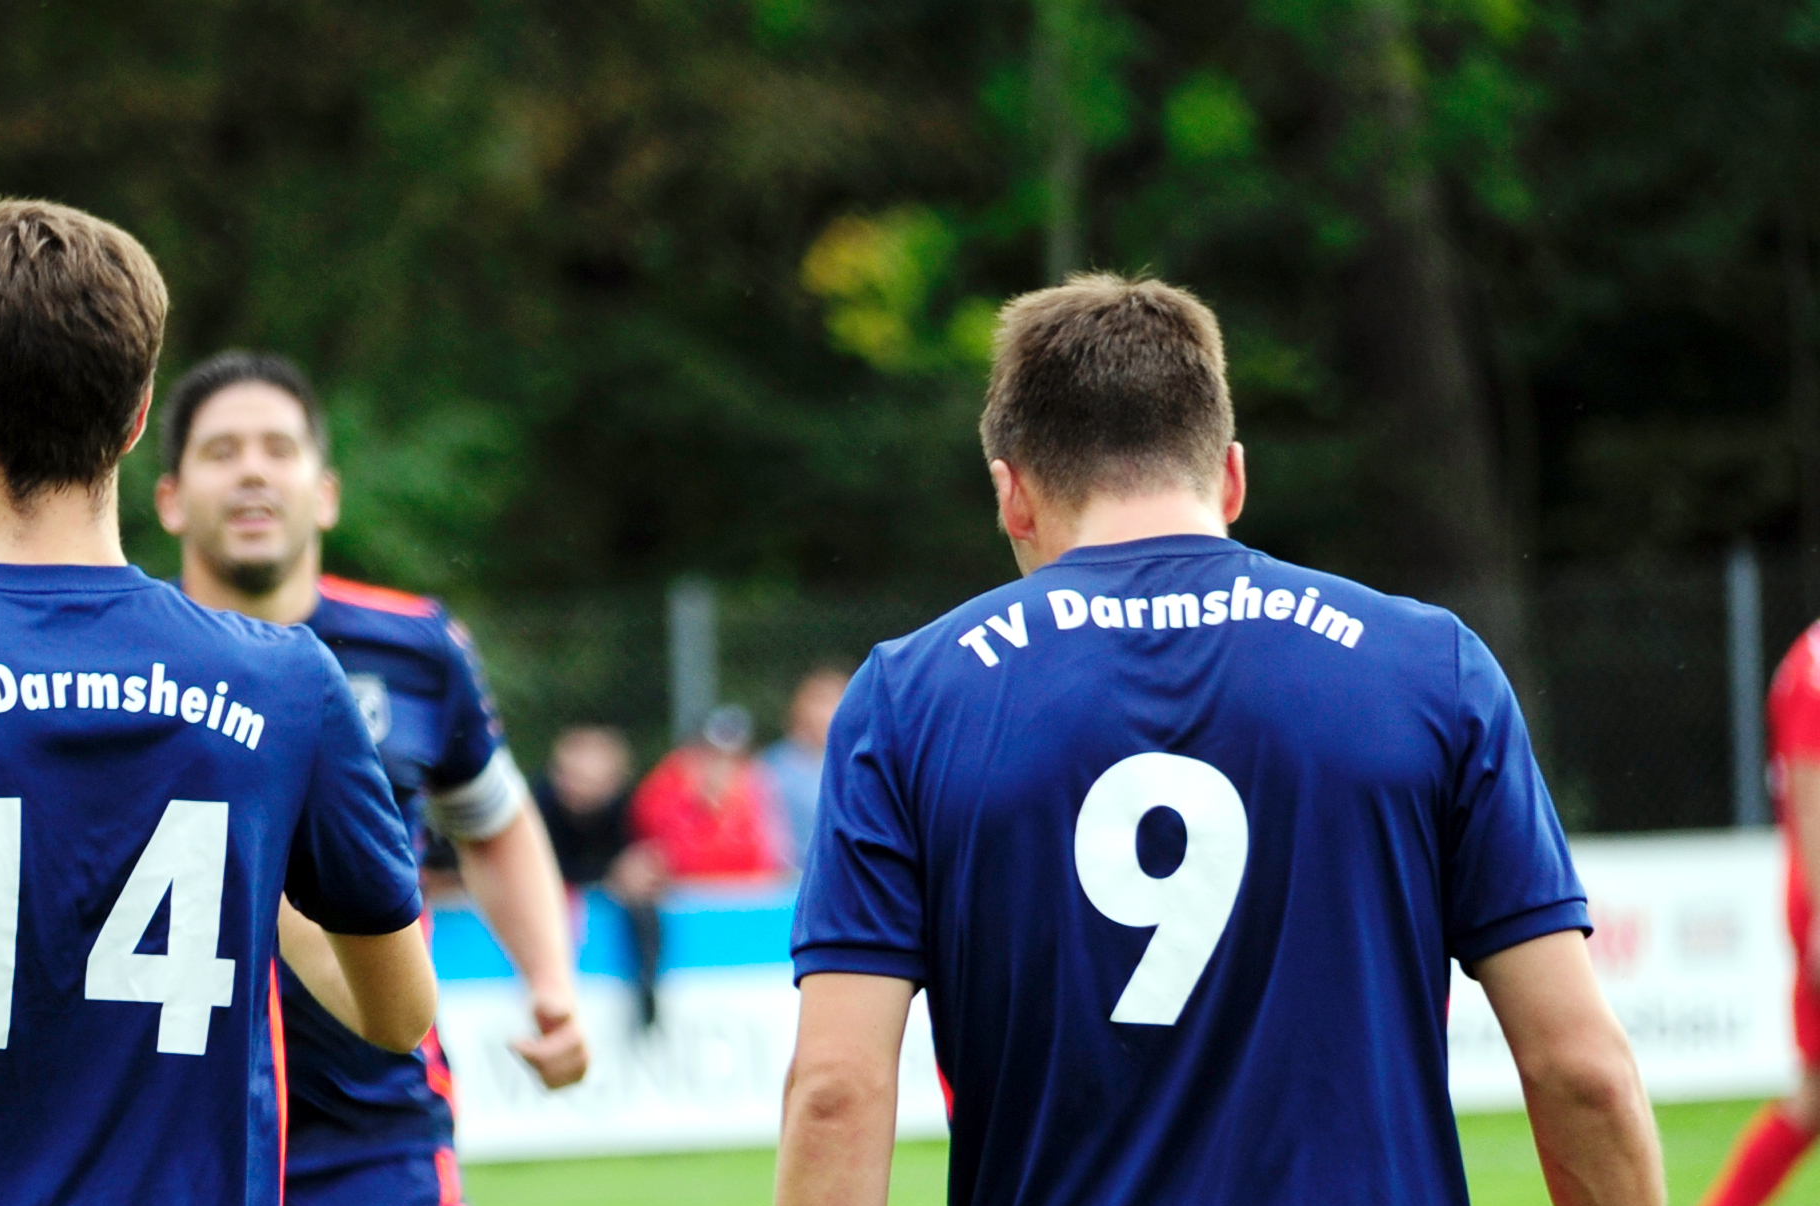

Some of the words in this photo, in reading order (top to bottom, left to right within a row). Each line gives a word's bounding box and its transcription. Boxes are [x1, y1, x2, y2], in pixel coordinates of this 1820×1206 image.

[958, 601, 1029, 668] TV
[1047, 576, 1364, 649] Darmsheim
[1074, 751, 1249, 1026] 9
